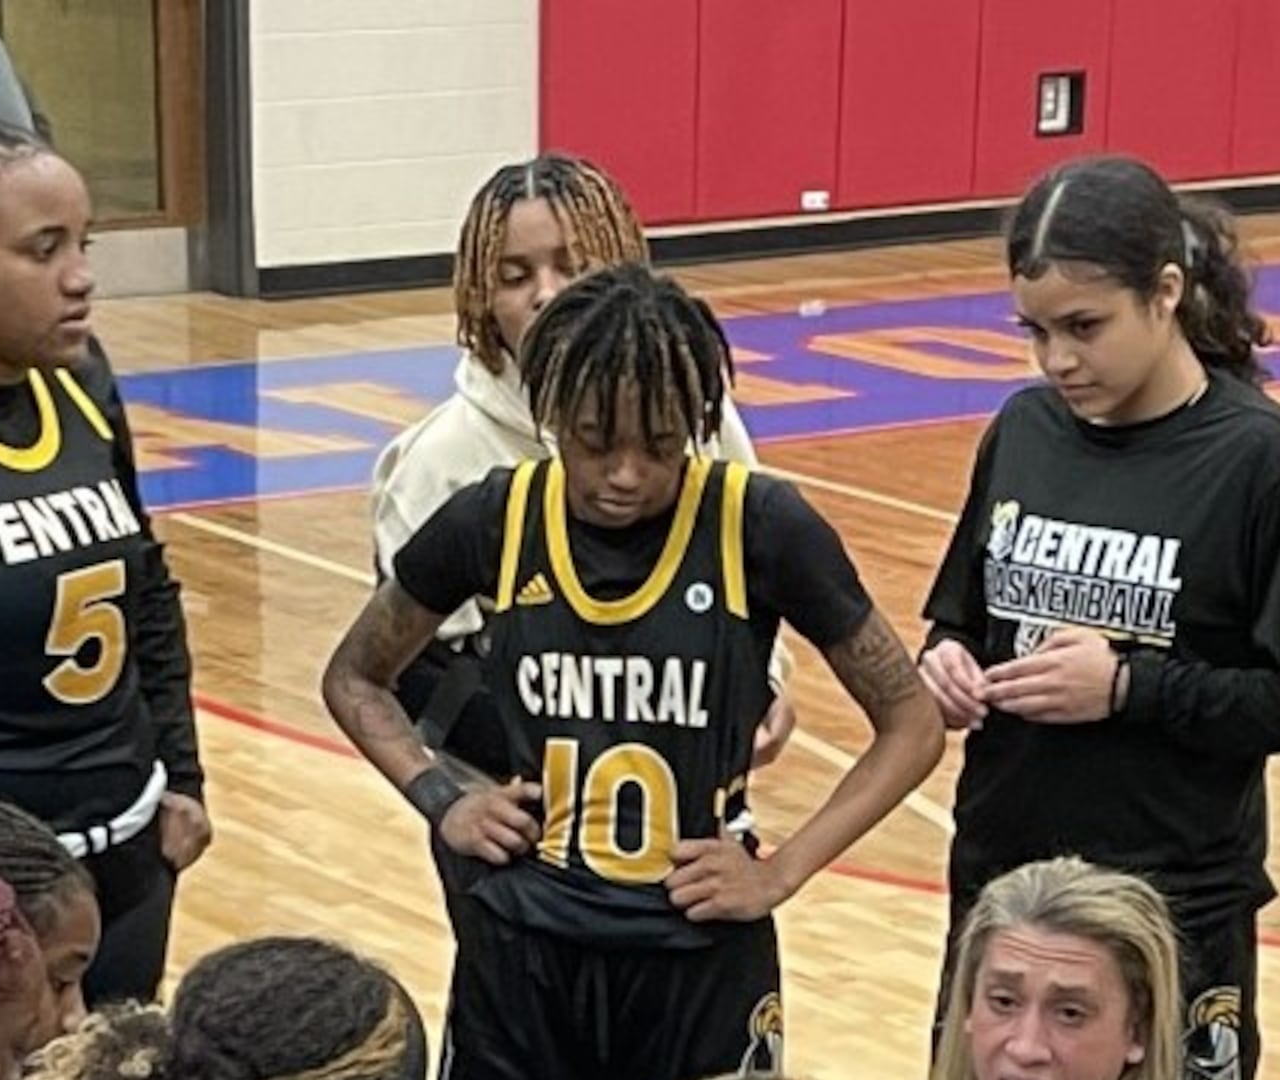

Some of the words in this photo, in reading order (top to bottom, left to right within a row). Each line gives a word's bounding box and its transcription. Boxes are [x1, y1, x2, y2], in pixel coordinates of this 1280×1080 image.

[1013, 514, 1182, 590] CENTRAL
[42, 557, 126, 704] 5
[518, 652, 708, 728] CENTRAL
[536, 736, 680, 884] 10
